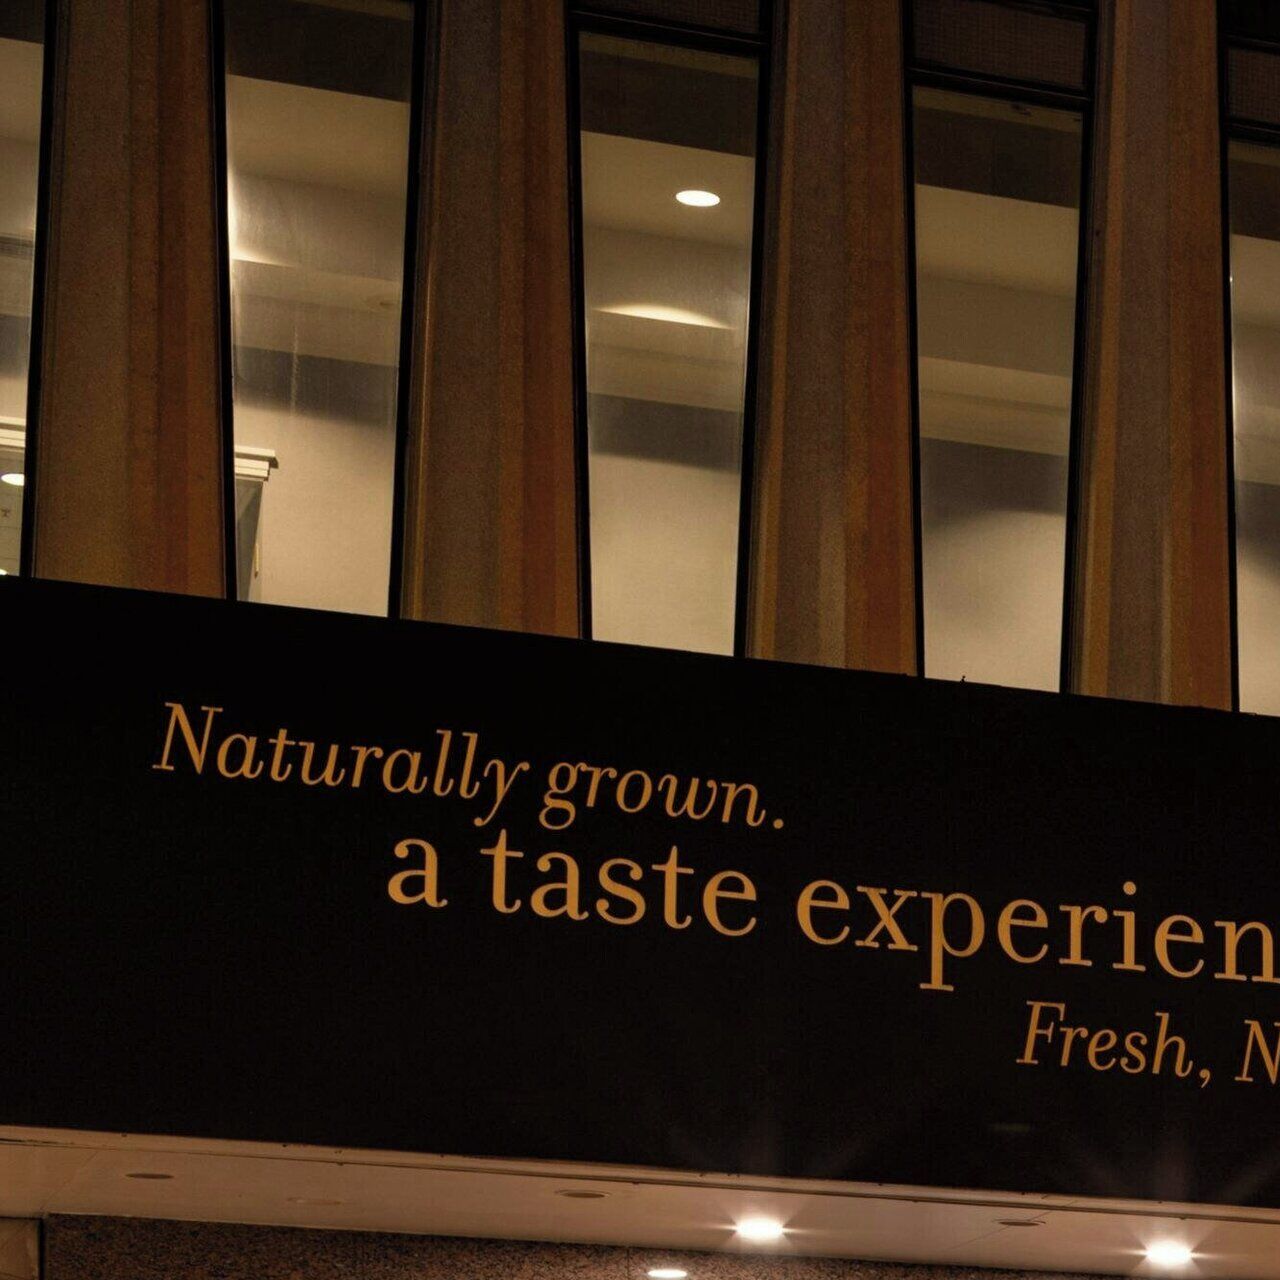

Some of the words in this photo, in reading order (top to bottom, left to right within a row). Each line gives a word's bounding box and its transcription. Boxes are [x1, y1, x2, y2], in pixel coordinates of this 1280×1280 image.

[155, 702, 530, 827] Naturally
[538, 762, 784, 830] grown.
[387, 838, 448, 908] a
[480, 829, 757, 937] taste
[1017, 1001, 1211, 1084] Fresh,
